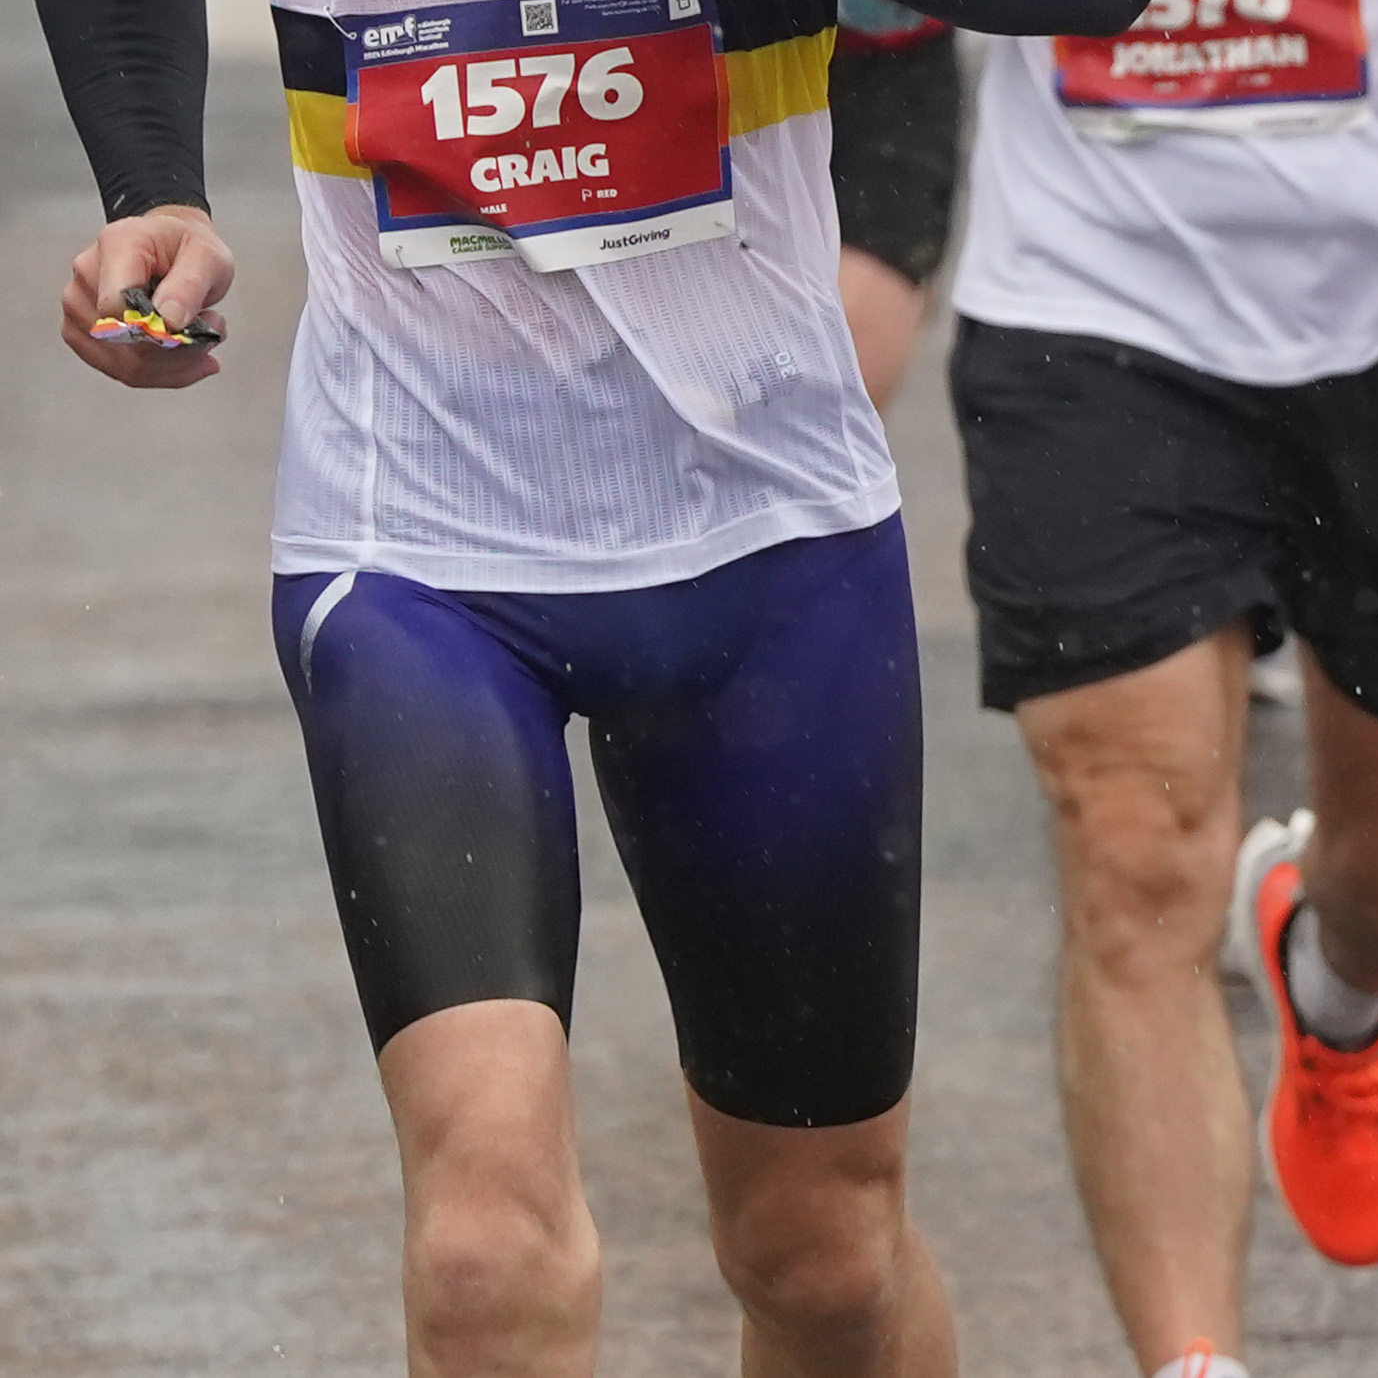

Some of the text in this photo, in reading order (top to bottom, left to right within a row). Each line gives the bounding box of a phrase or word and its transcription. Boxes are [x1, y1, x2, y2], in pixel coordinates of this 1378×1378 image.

[1110, 33, 1308, 80] JONATHAN
[420, 46, 644, 141] 1576
[470, 142, 610, 193] CRAIG
[480, 203, 508, 215] MALE
[596, 188, 618, 199] RED
[599, 228, 670, 251] JustGiving
